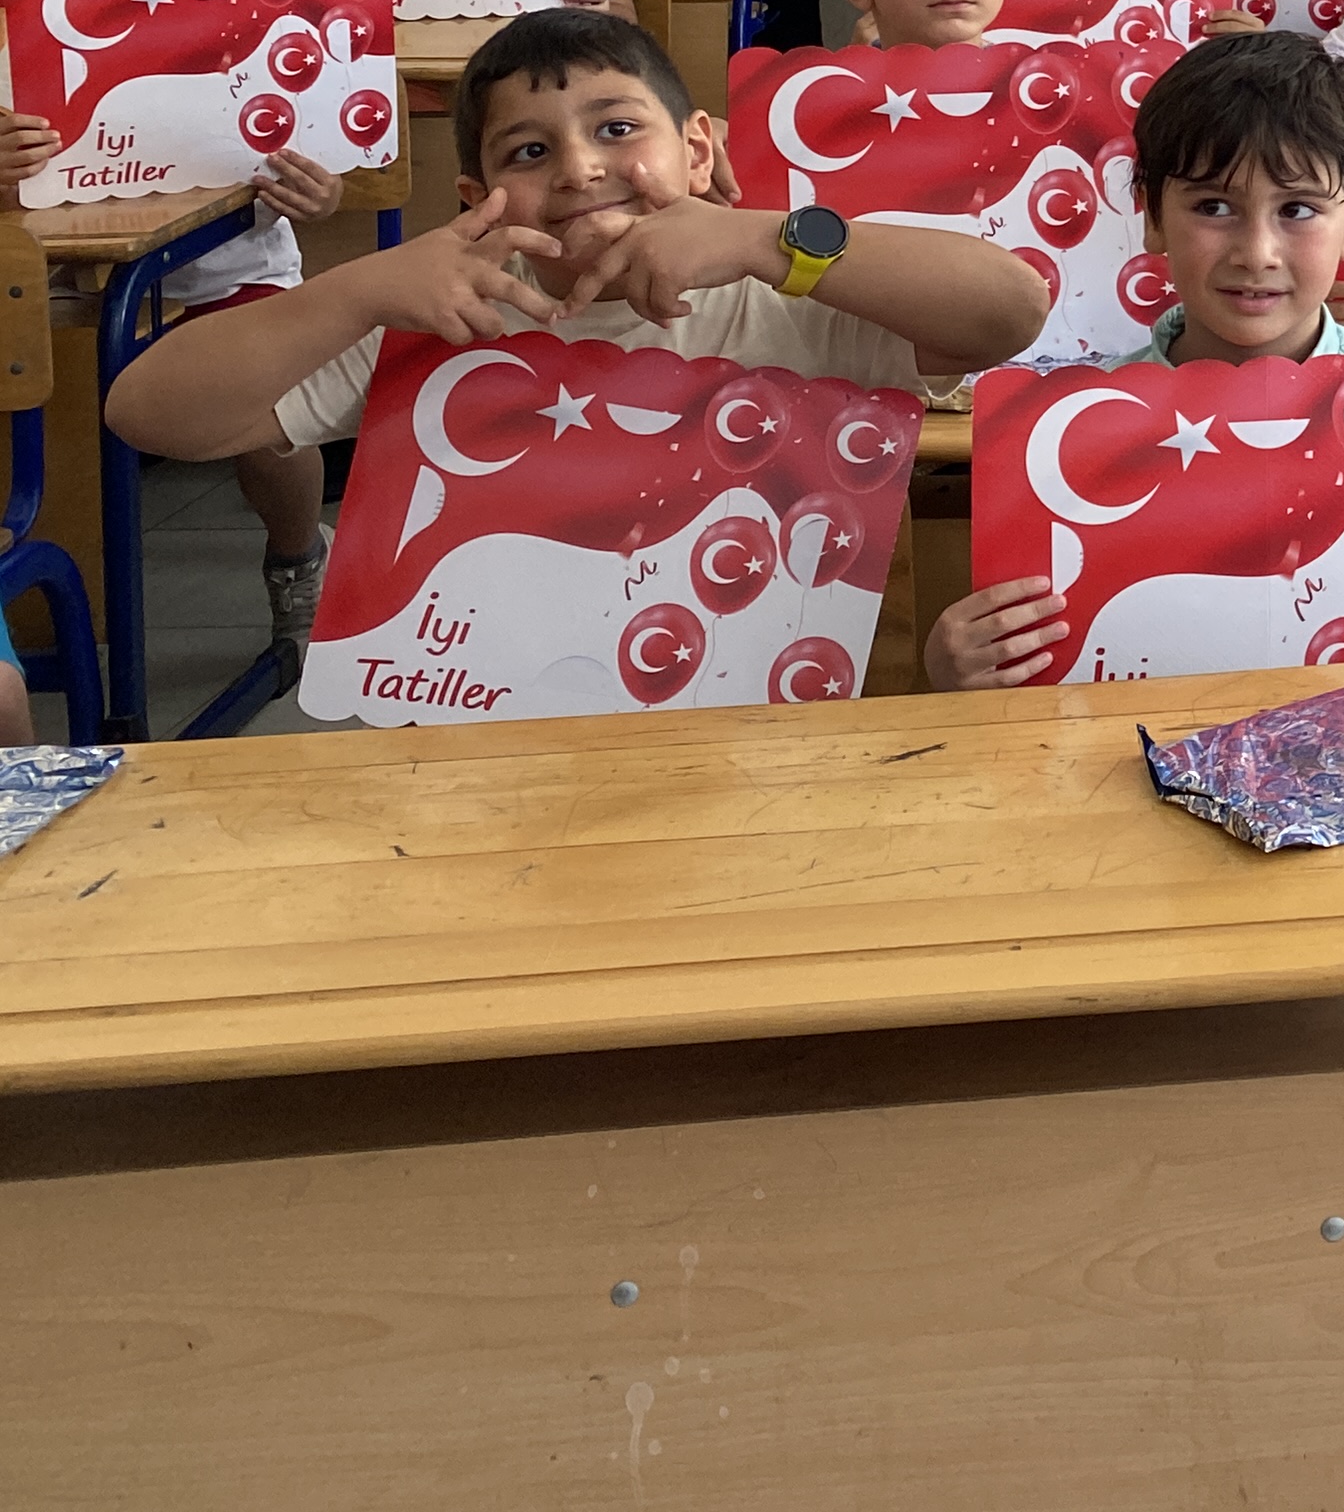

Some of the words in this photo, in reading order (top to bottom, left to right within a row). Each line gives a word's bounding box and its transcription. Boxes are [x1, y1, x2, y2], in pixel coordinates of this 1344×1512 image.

[97, 123, 135, 158] İyi
[58, 160, 175, 190] Tatiller
[417, 592, 476, 655] İyi
[356, 658, 512, 712] Tatiller
